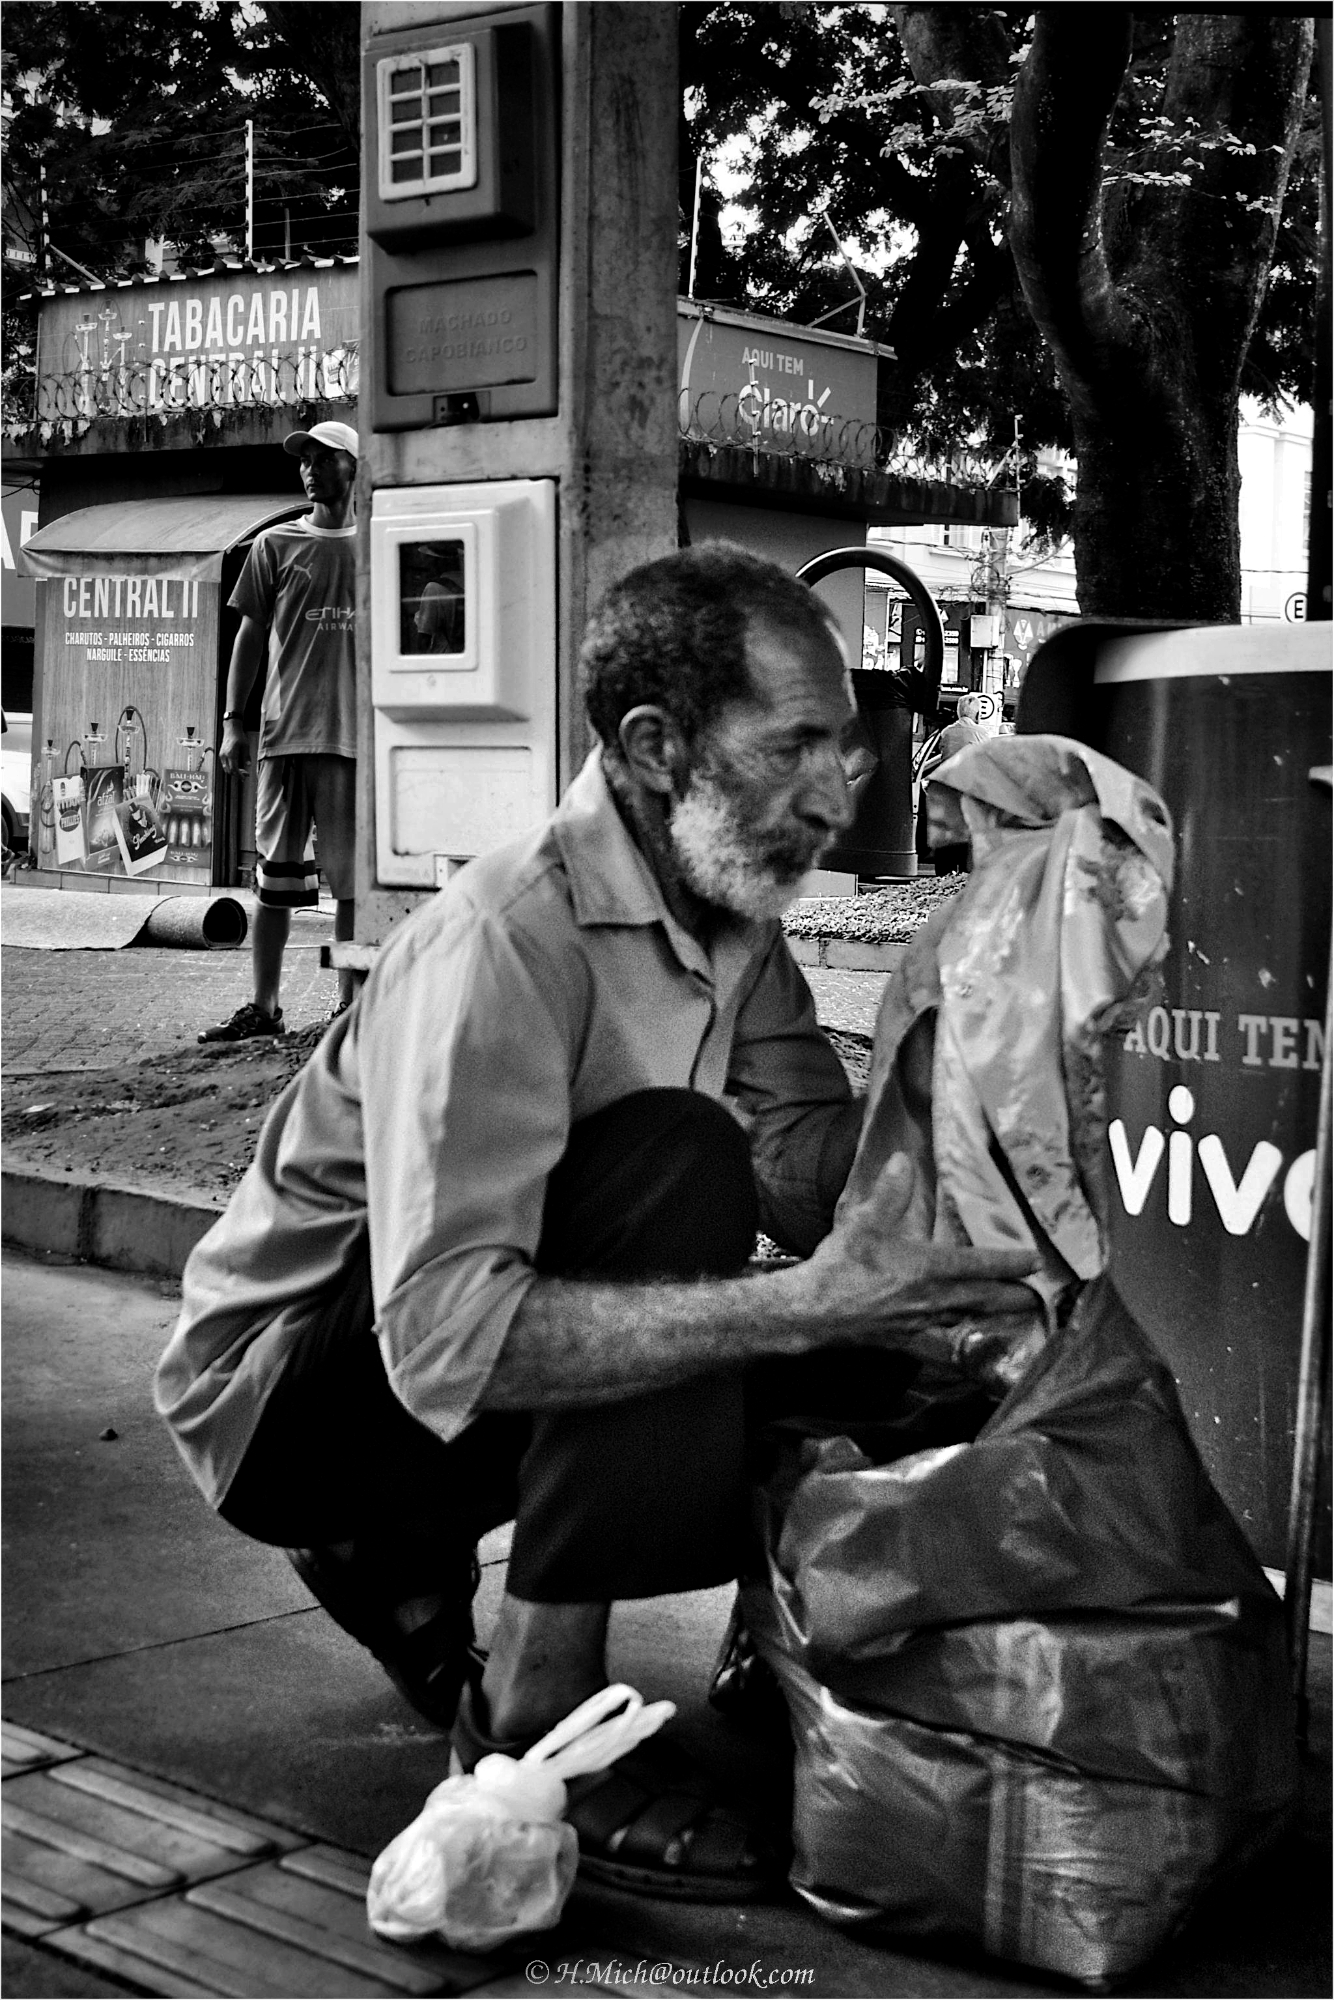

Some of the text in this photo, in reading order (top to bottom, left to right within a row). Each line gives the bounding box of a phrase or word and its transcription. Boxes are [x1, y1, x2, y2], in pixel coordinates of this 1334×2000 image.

[148, 286, 321, 352] TABACARIA
[419, 309, 512, 334] MACHADO
[742, 347, 804, 376] AQUI TEM
[149, 348, 287, 408] CENTRAL
[738, 384, 820, 437] Claro
[64, 577, 175, 618] CENTRAL
[1294, 599, 1304, 619] E
[65, 632, 103, 646] CHARUTOS
[109, 632, 150, 646] PALHEIROS
[156, 633, 194, 647] CIGARROS
[318, 622, 354, 632] AIRWA
[86, 648, 122, 661] NARGUILE
[128, 645, 170, 663] ESSÊNCIAS
[1123, 1006, 1220, 1061] AQUI
